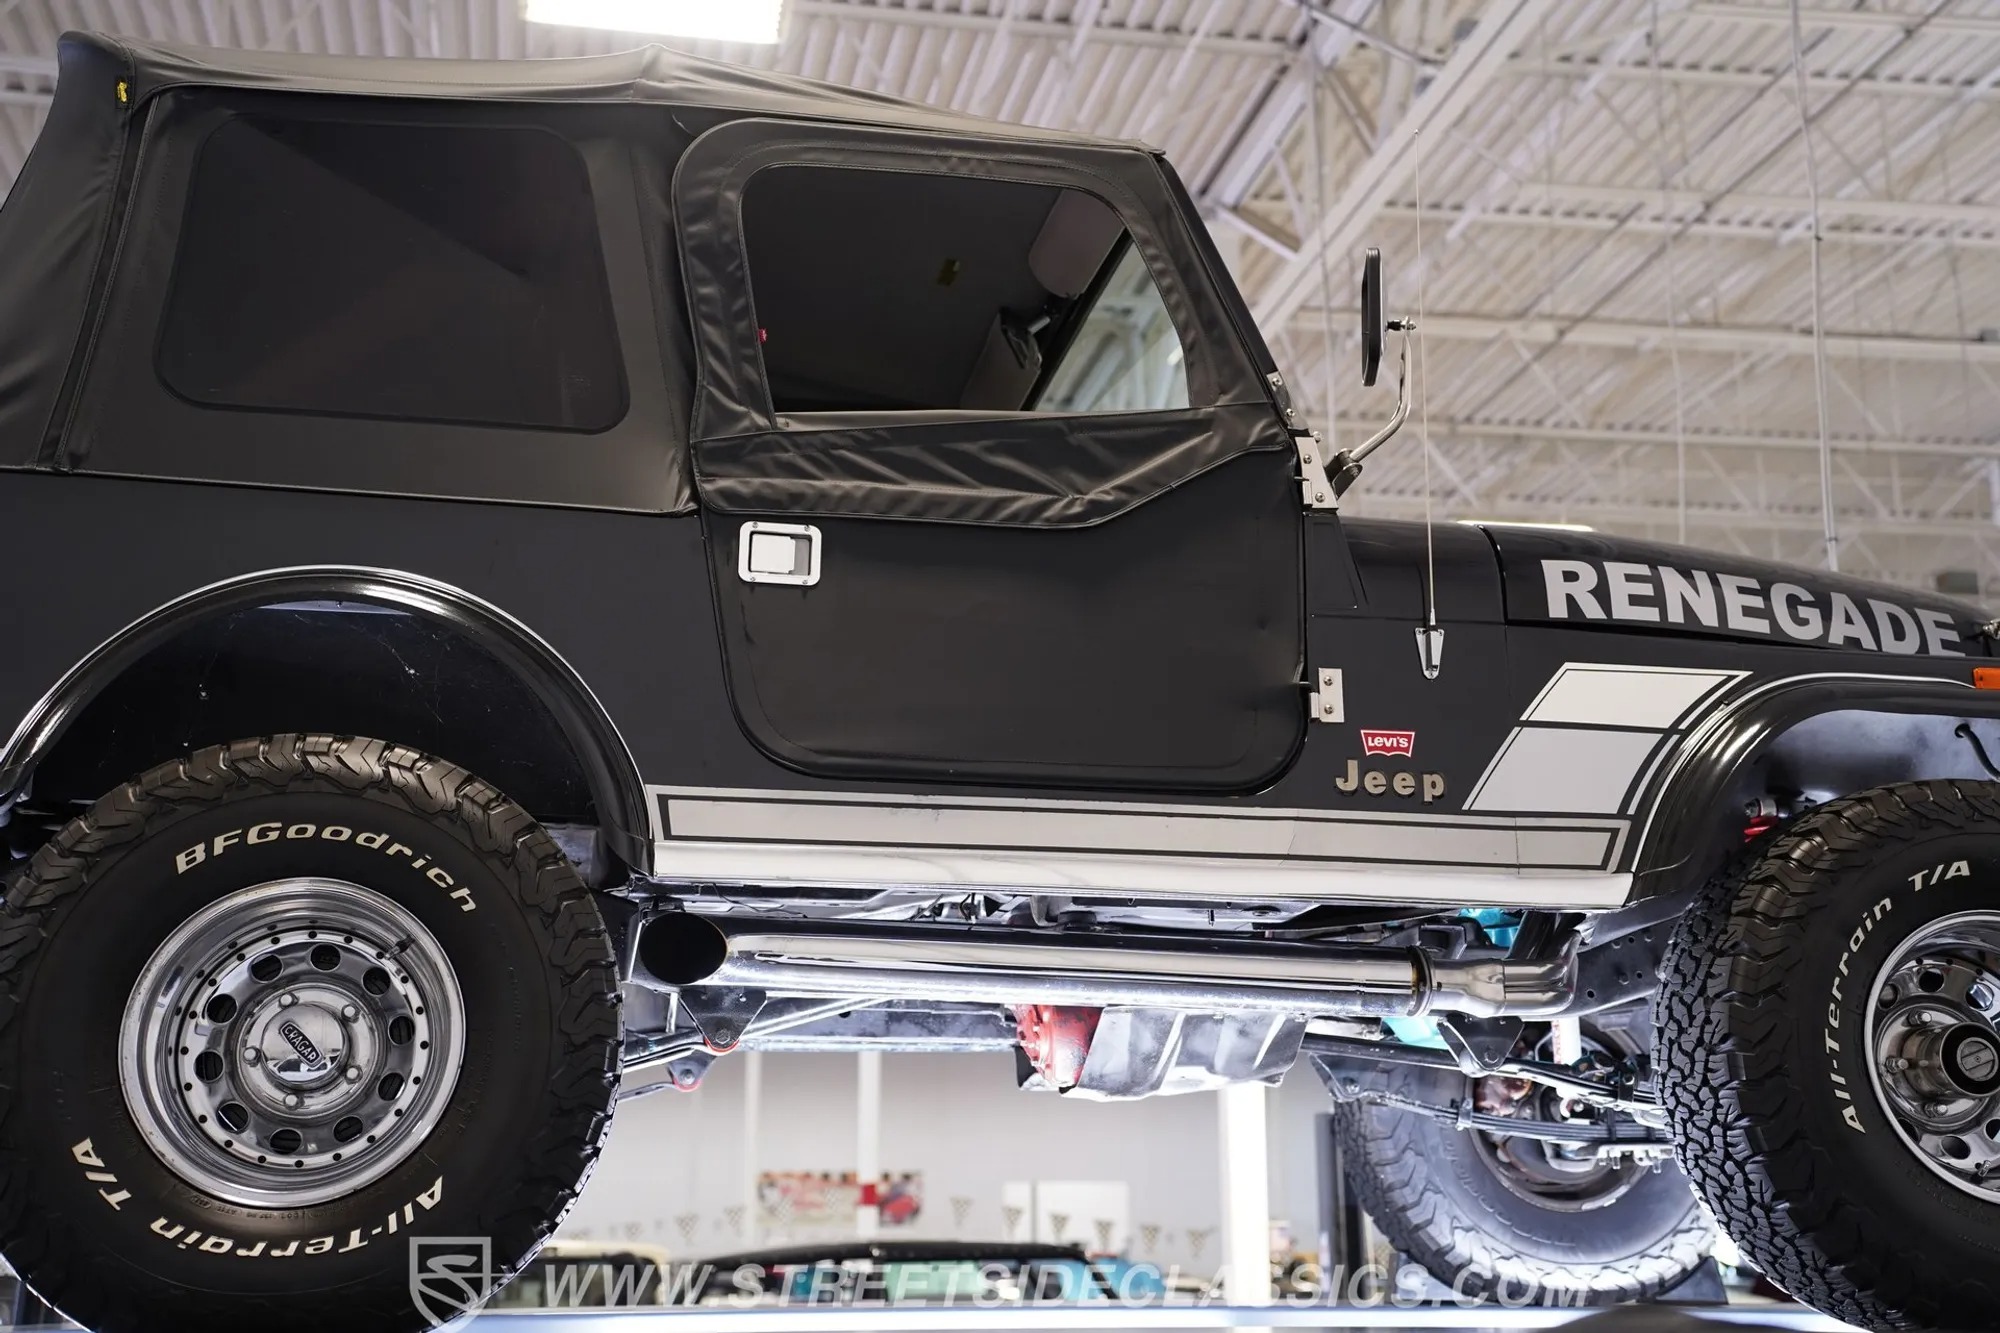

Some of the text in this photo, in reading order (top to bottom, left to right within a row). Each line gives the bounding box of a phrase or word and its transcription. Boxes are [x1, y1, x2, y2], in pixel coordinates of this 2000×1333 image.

[1540, 559, 1966, 657] RENEGADE
[1335, 759, 1445, 802] Jeep
[175, 821, 477, 913] BFGoodrich
[284, 1026, 317, 1061] CRAGAR
[1825, 860, 1971, 1135] All-Terrain T/A
[71, 1136, 444, 1257] All-Terrain T/A
